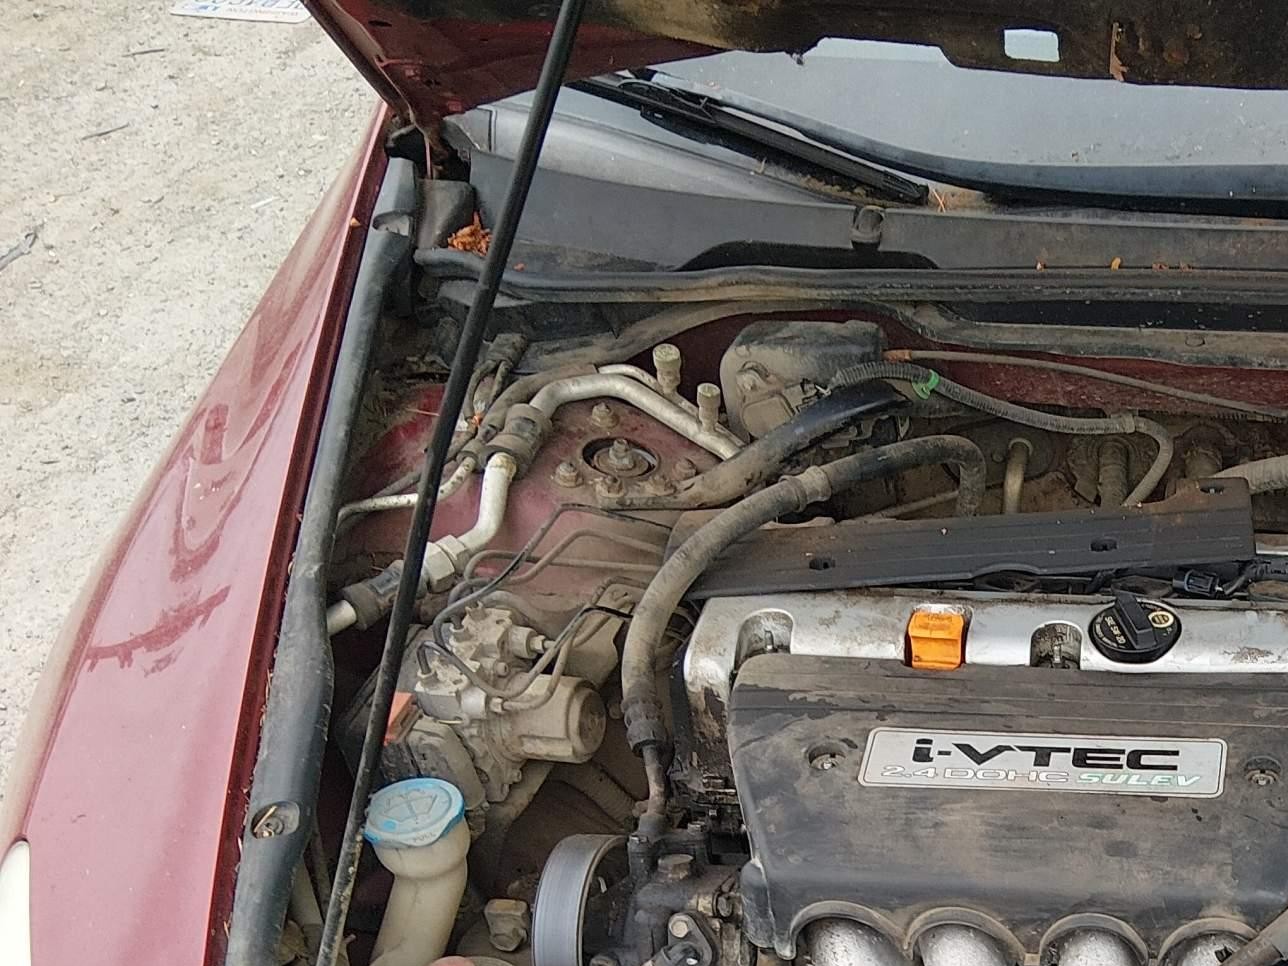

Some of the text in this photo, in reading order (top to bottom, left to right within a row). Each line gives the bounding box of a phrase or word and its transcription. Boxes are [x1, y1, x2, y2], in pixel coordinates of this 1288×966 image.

[911, 738, 1180, 771] i-VTEC
[881, 765, 1201, 787] 2.4 DOHC SULEV
